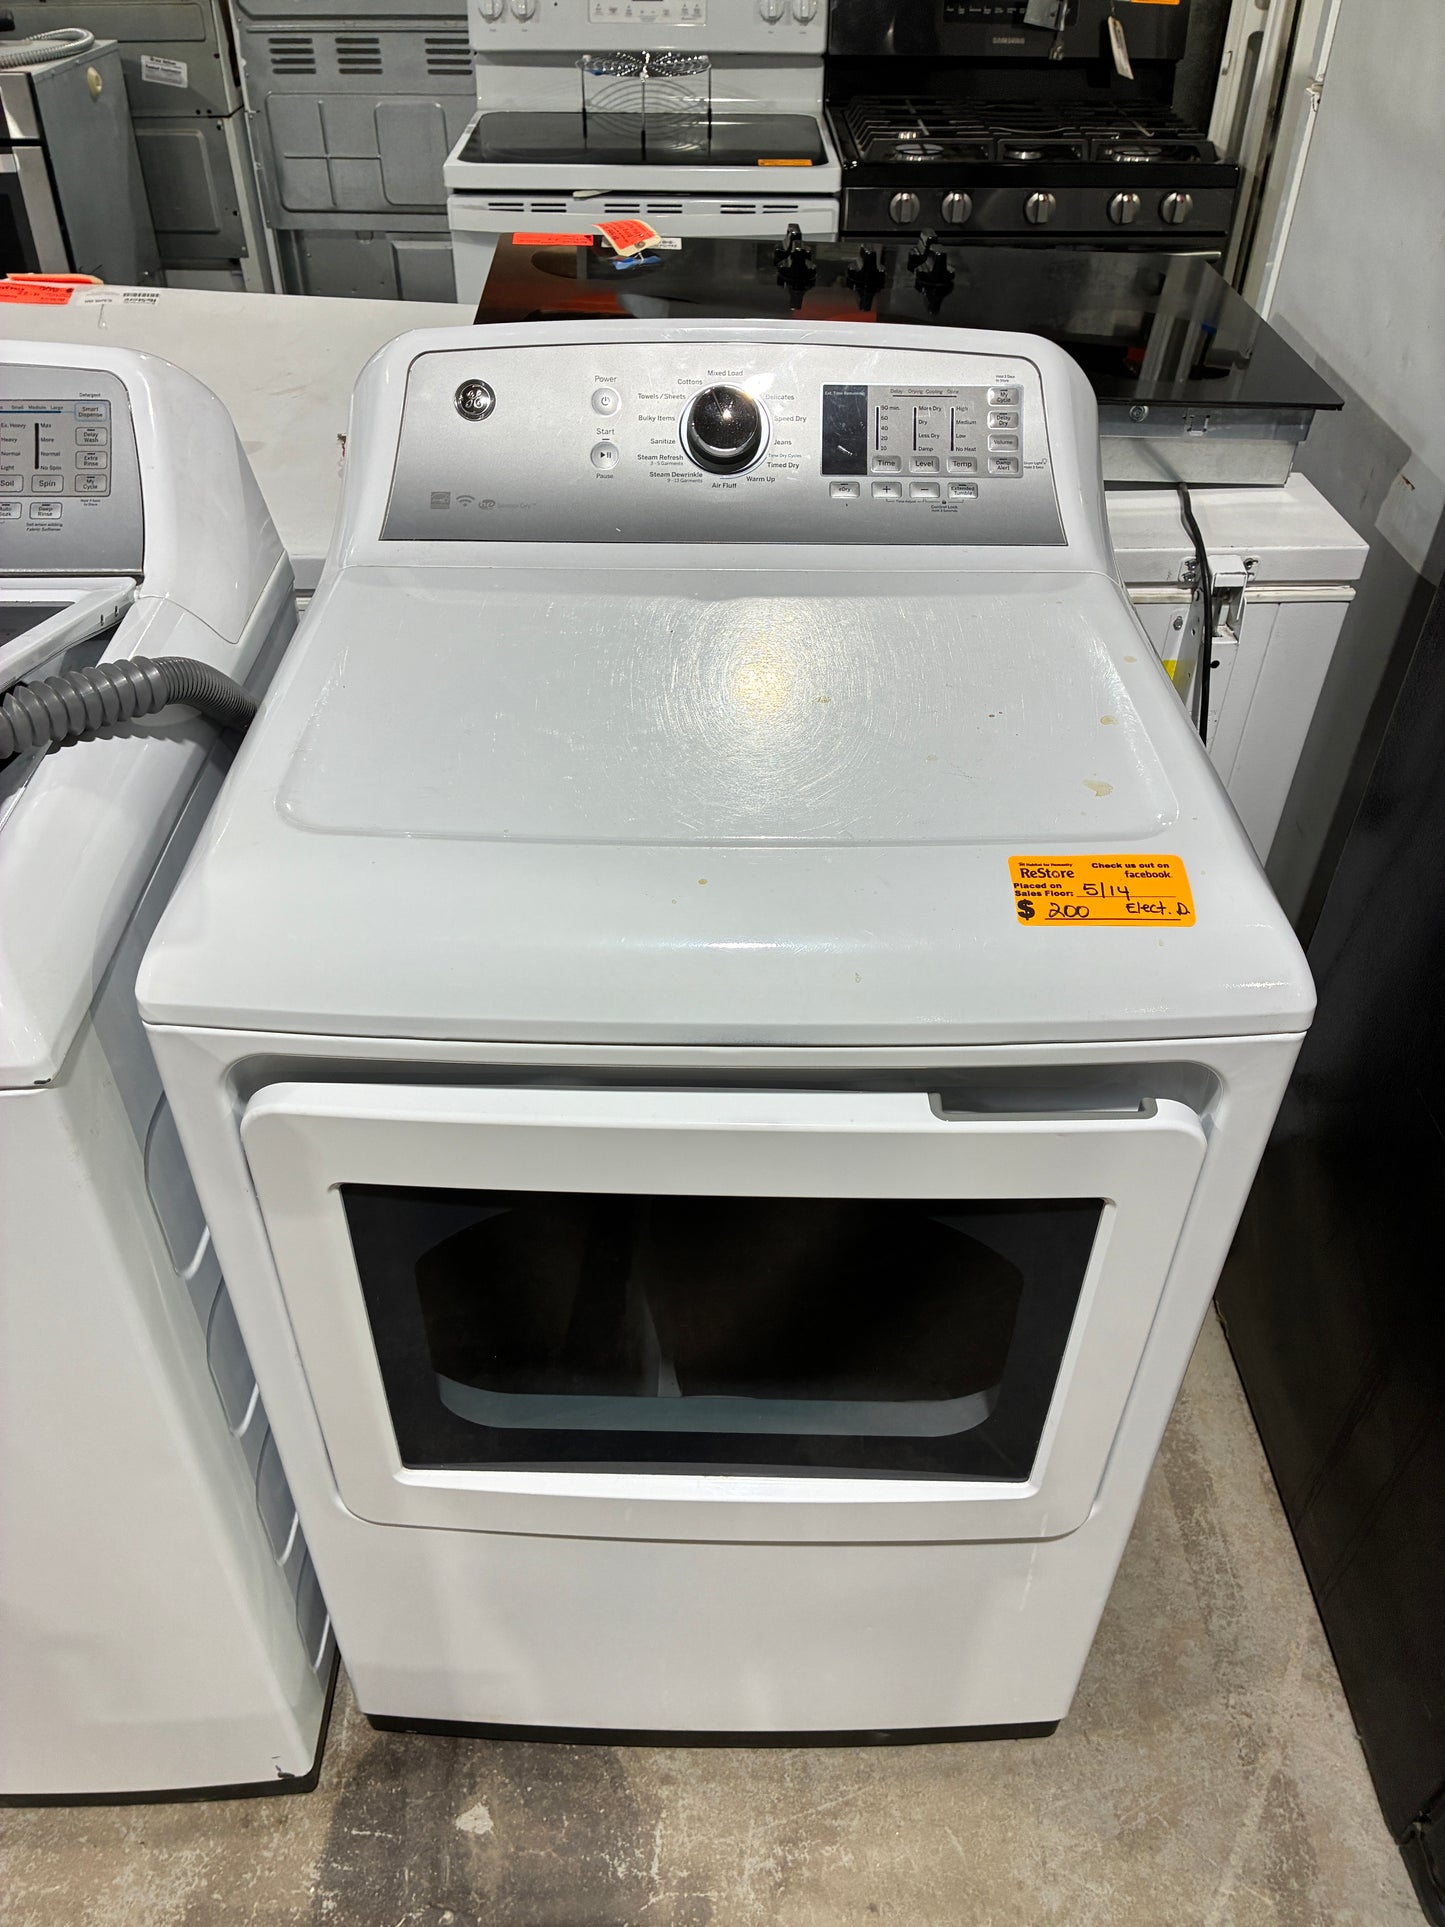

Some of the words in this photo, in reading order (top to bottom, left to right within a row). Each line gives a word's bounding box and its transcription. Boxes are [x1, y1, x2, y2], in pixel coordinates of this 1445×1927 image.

[595, 375, 617, 383] Power
[788, 461, 800, 469] Dry
[953, 460, 973, 468] Temp
[39, 480, 56, 488] Spin
[766, 476, 776, 484] Up
[1020, 867, 1075, 879] ReStore
[1124, 870, 1171, 878] facebook
[1083, 882, 1130, 901] 5/14
[1017, 899, 1035, 921] $
[1049, 902, 1090, 918] 200
[1126, 901, 1172, 916] Elect.
